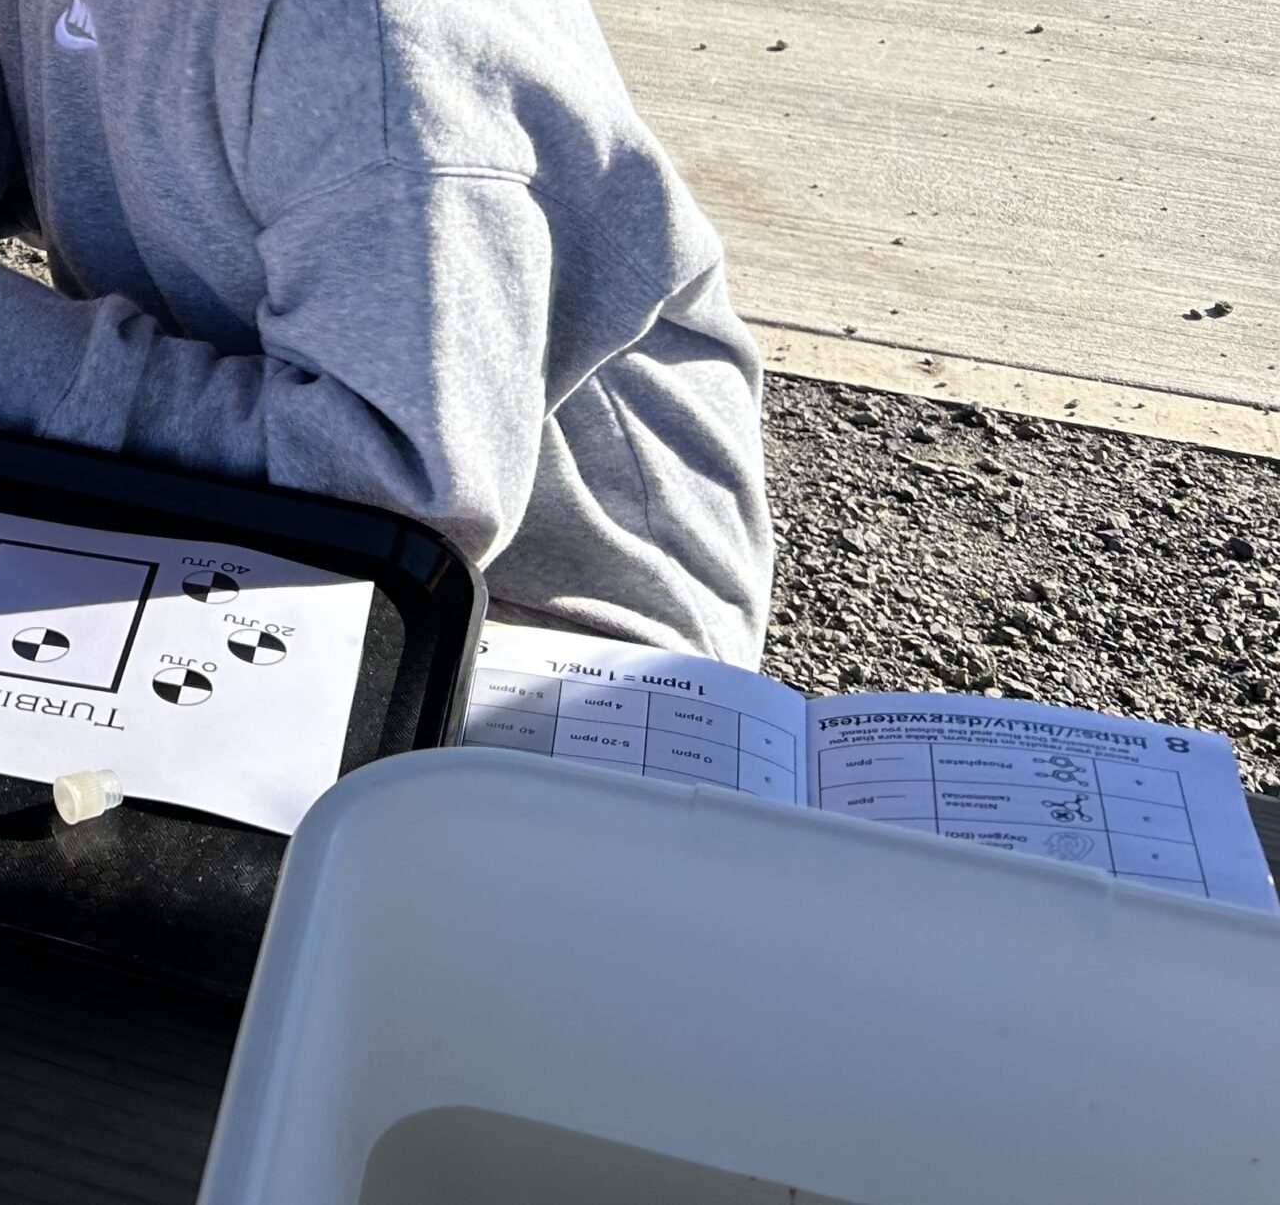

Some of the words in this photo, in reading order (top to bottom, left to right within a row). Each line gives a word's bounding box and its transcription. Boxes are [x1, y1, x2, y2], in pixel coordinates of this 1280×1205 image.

[181, 556, 216, 567] JTU
[221, 563, 251, 574] 40
[223, 614, 260, 627] JTU
[264, 624, 295, 637] 20
[159, 654, 197, 667] JTU
[202, 662, 217, 673] 0
[544, 660, 603, 677] mg/L
[609, 670, 617, 682] 1
[641, 675, 692, 691] ppm
[488, 684, 516, 694] ppm
[697, 685, 706, 696] 1
[584, 698, 613, 709] ppm
[615, 702, 623, 711] 4
[674, 711, 704, 723] ppm
[705, 718, 713, 726] 2
[485, 721, 513, 732] ppm
[518, 726, 537, 736] 40
[818, 712, 1147, 750] https://bit.ly/dsrgwatertest
[569, 733, 598, 744] ppm
[601, 737, 631, 748] 5-20
[1165, 737, 1190, 753] 8
[671, 748, 701, 761] ppm
[703, 755, 713, 764] 0
[846, 758, 873, 768] ppm
[938, 759, 1013, 769] Phosphates
[847, 796, 875, 806] ppm
[945, 801, 998, 810] Nitrates
[944, 831, 975, 840] (DO)
[978, 833, 1027, 842] Oxygen
